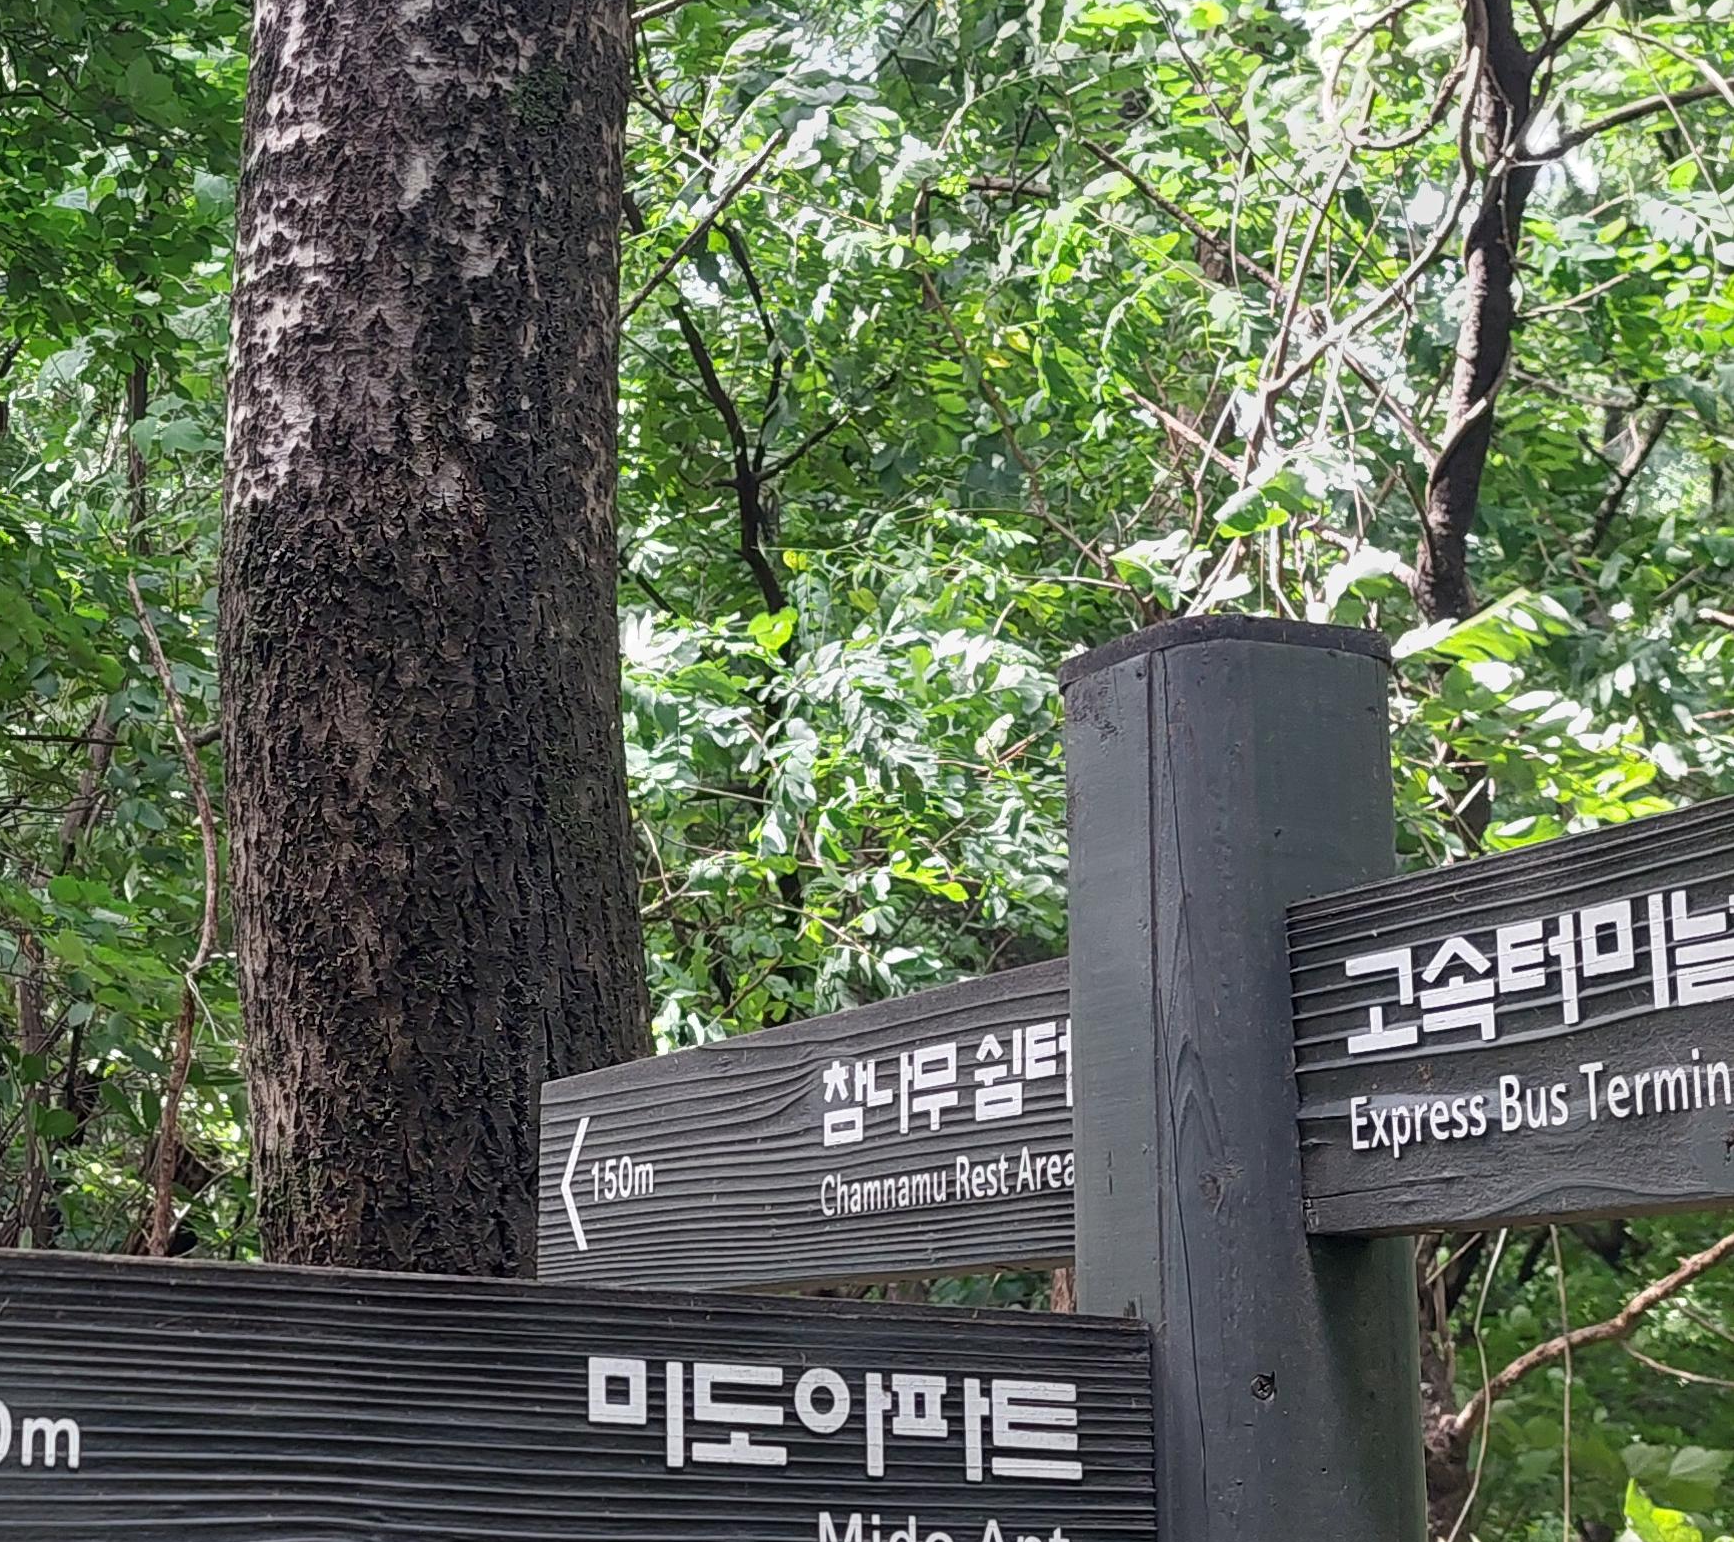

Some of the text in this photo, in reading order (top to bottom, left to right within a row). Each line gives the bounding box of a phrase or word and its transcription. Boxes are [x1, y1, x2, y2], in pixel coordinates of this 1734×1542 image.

[1346, 890, 1734, 1053] 고속터미널
[823, 1019, 1073, 1146] 참나무쉼터
[1350, 1047, 1732, 1159] Express Bus Termin
[591, 1155, 655, 1202] 150m
[820, 1145, 1075, 1218] Chamnamu Rest Area
[588, 1356, 1083, 1481] 미도아파트
